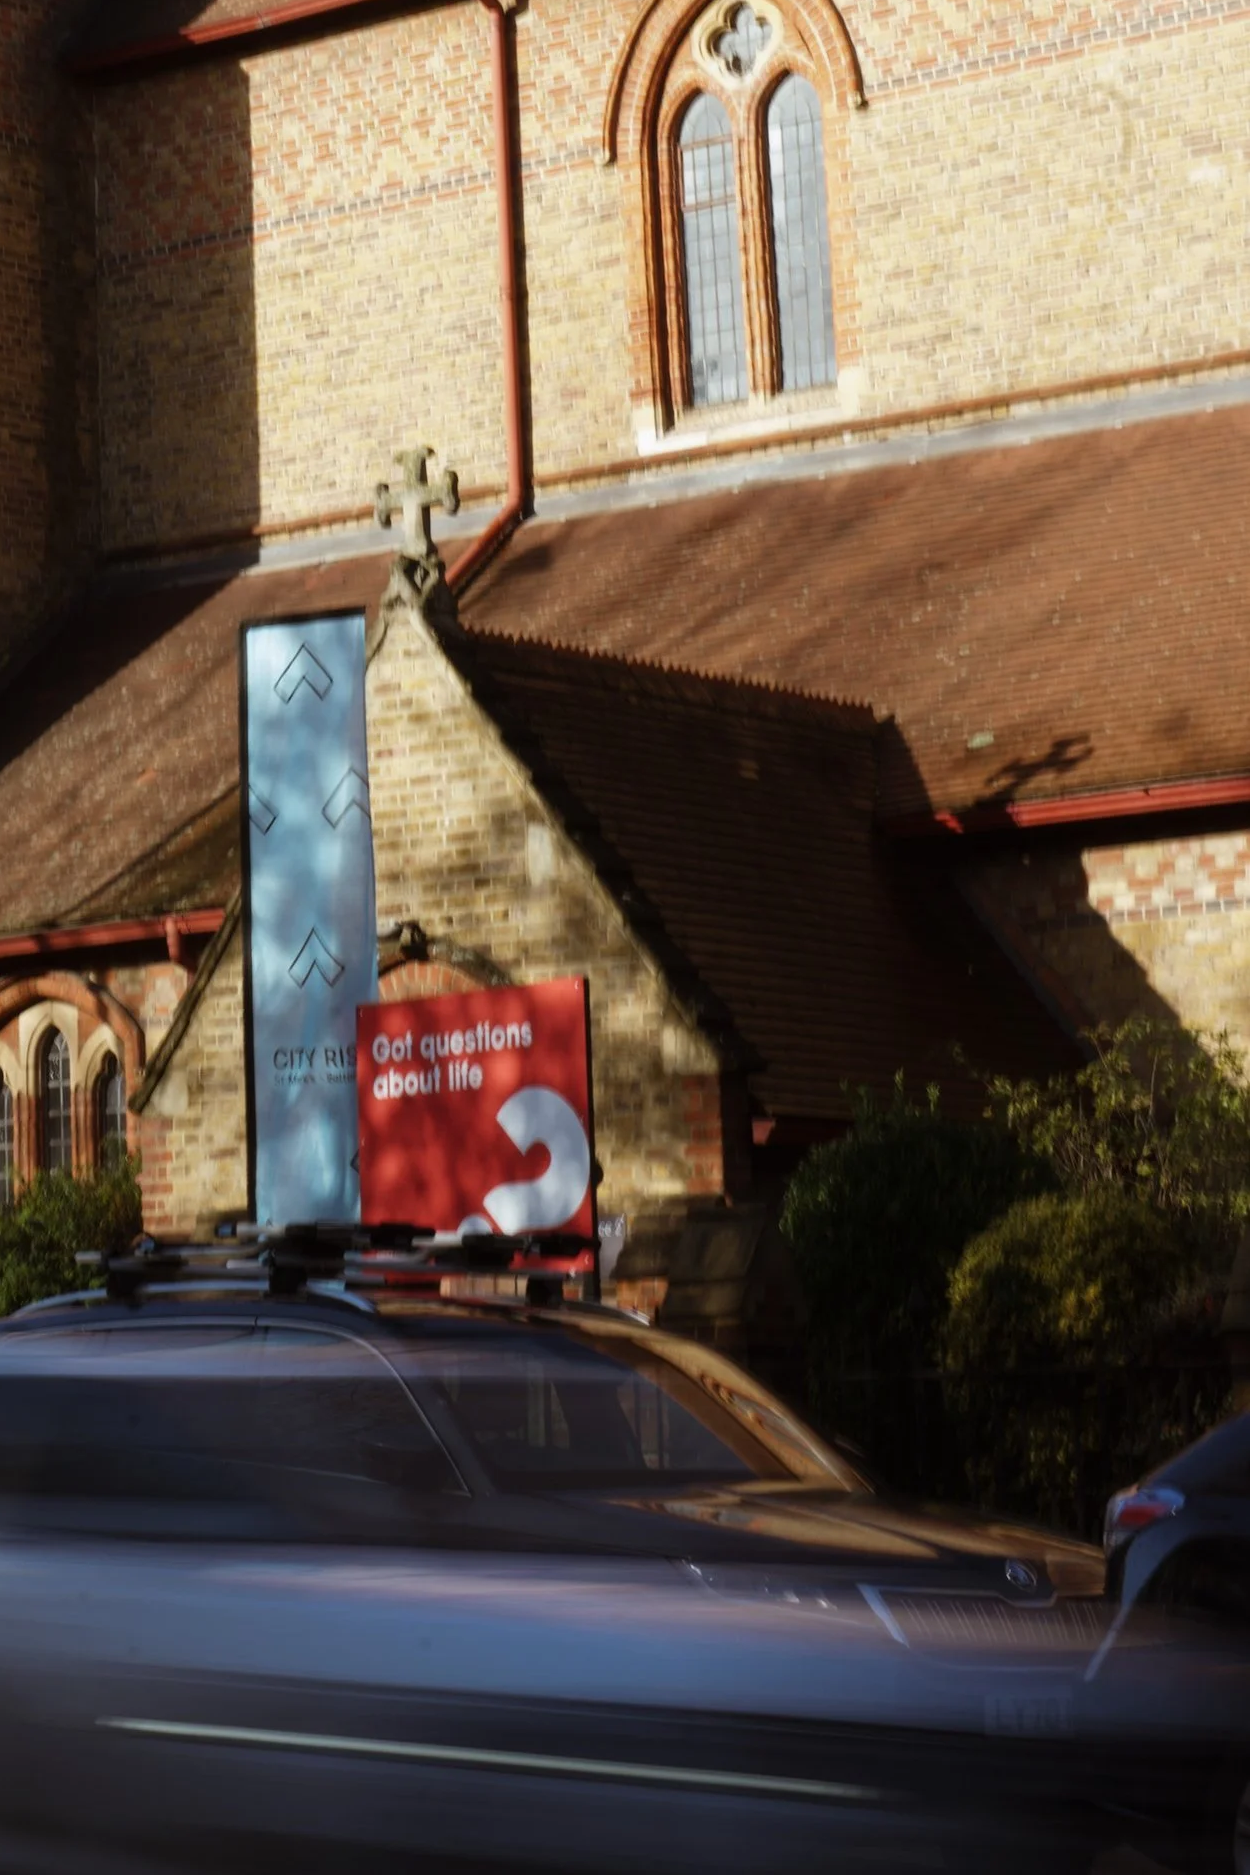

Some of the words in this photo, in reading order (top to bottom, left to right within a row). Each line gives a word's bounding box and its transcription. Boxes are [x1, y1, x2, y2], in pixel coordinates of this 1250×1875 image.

[273, 1047, 316, 1070] CITY
[324, 1043, 357, 1068] RIS
[372, 1031, 412, 1064] Got
[420, 1021, 533, 1062] questions
[372, 1066, 440, 1101] about
[448, 1059, 483, 1093] life
